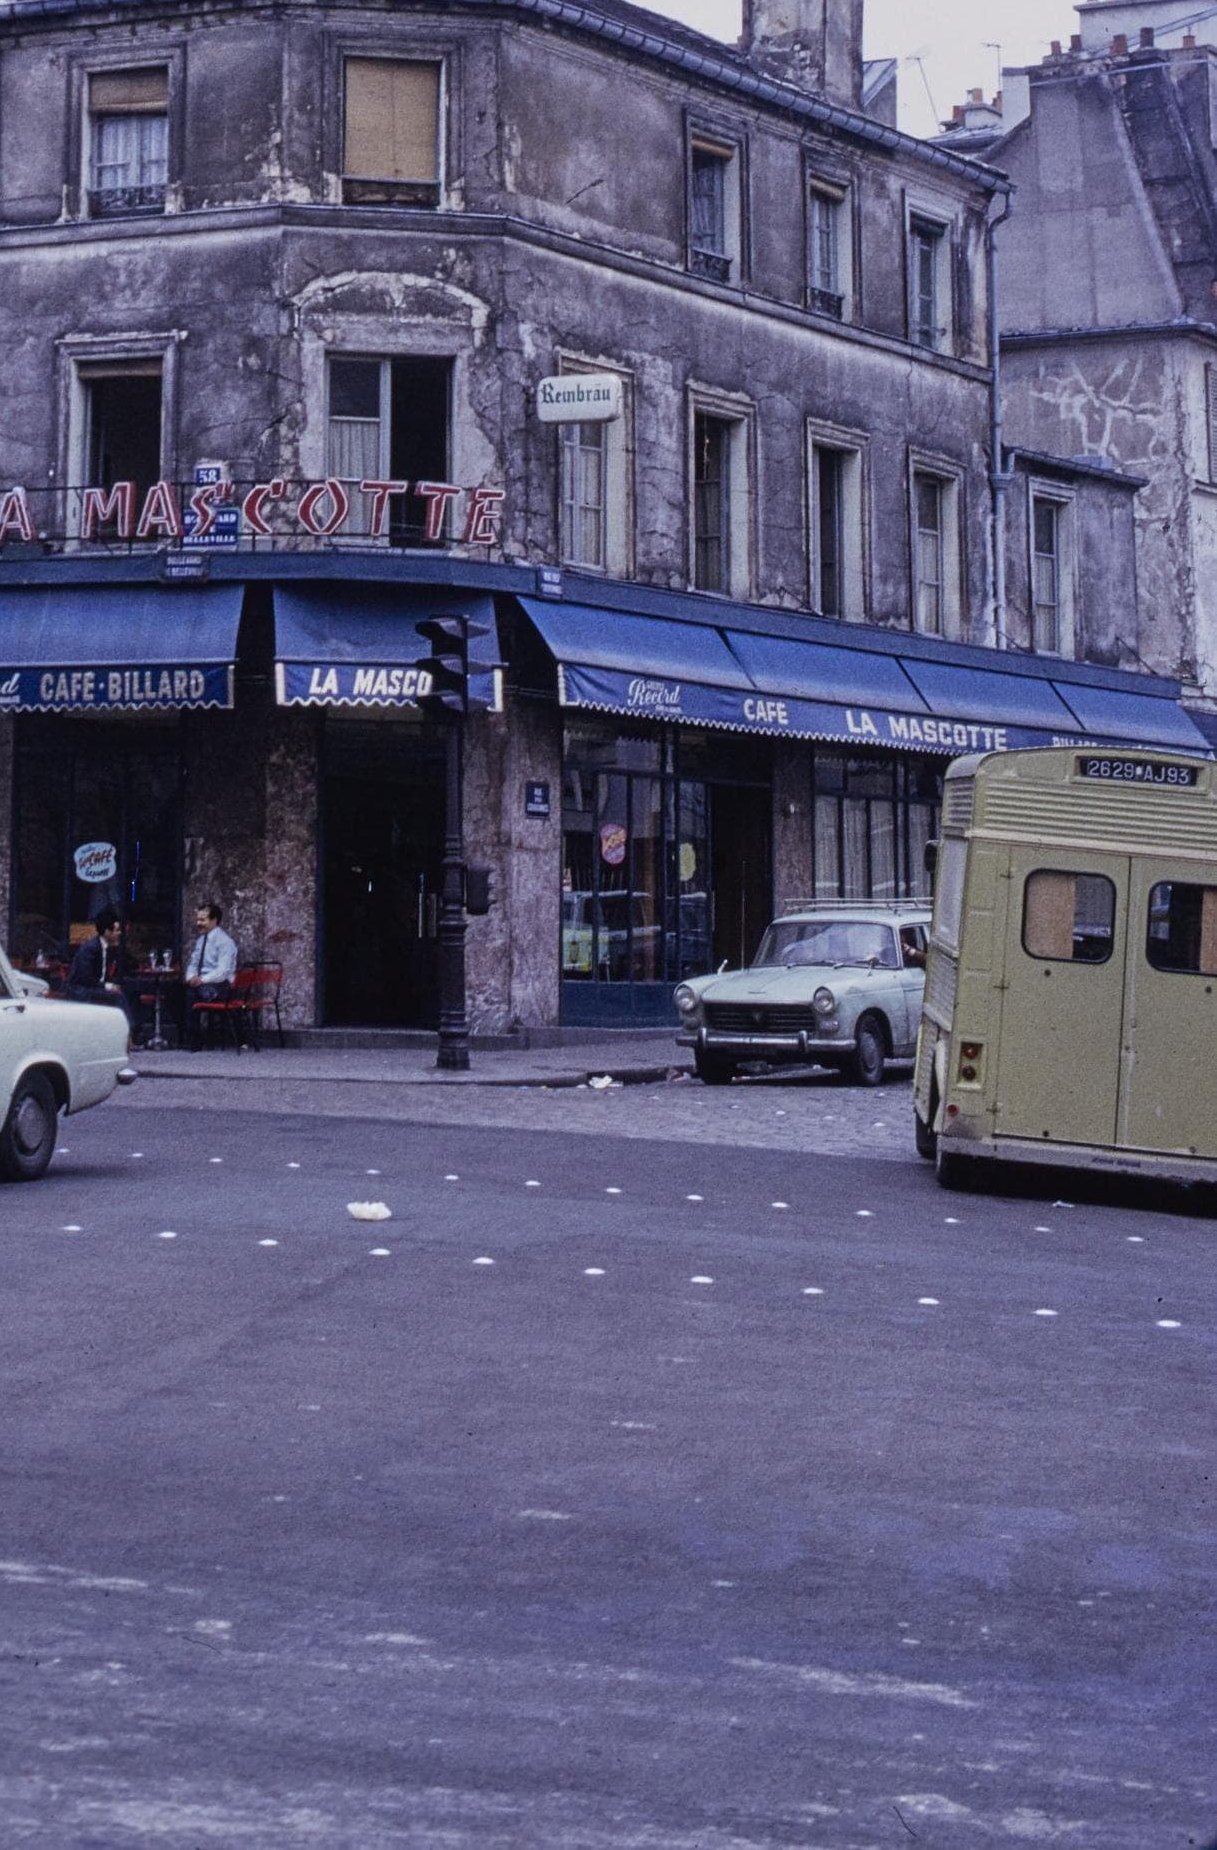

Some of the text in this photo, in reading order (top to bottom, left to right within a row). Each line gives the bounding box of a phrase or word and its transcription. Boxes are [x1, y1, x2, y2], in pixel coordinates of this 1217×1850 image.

[199, 470, 217, 483] 58
[82, 480, 506, 544] MASCOTTE
[40, 672, 95, 701] CAFE
[108, 670, 205, 699] BILLARD
[309, 668, 339, 694] LA
[628, 679, 1007, 751] Record CAFE LA MASCOTTE
